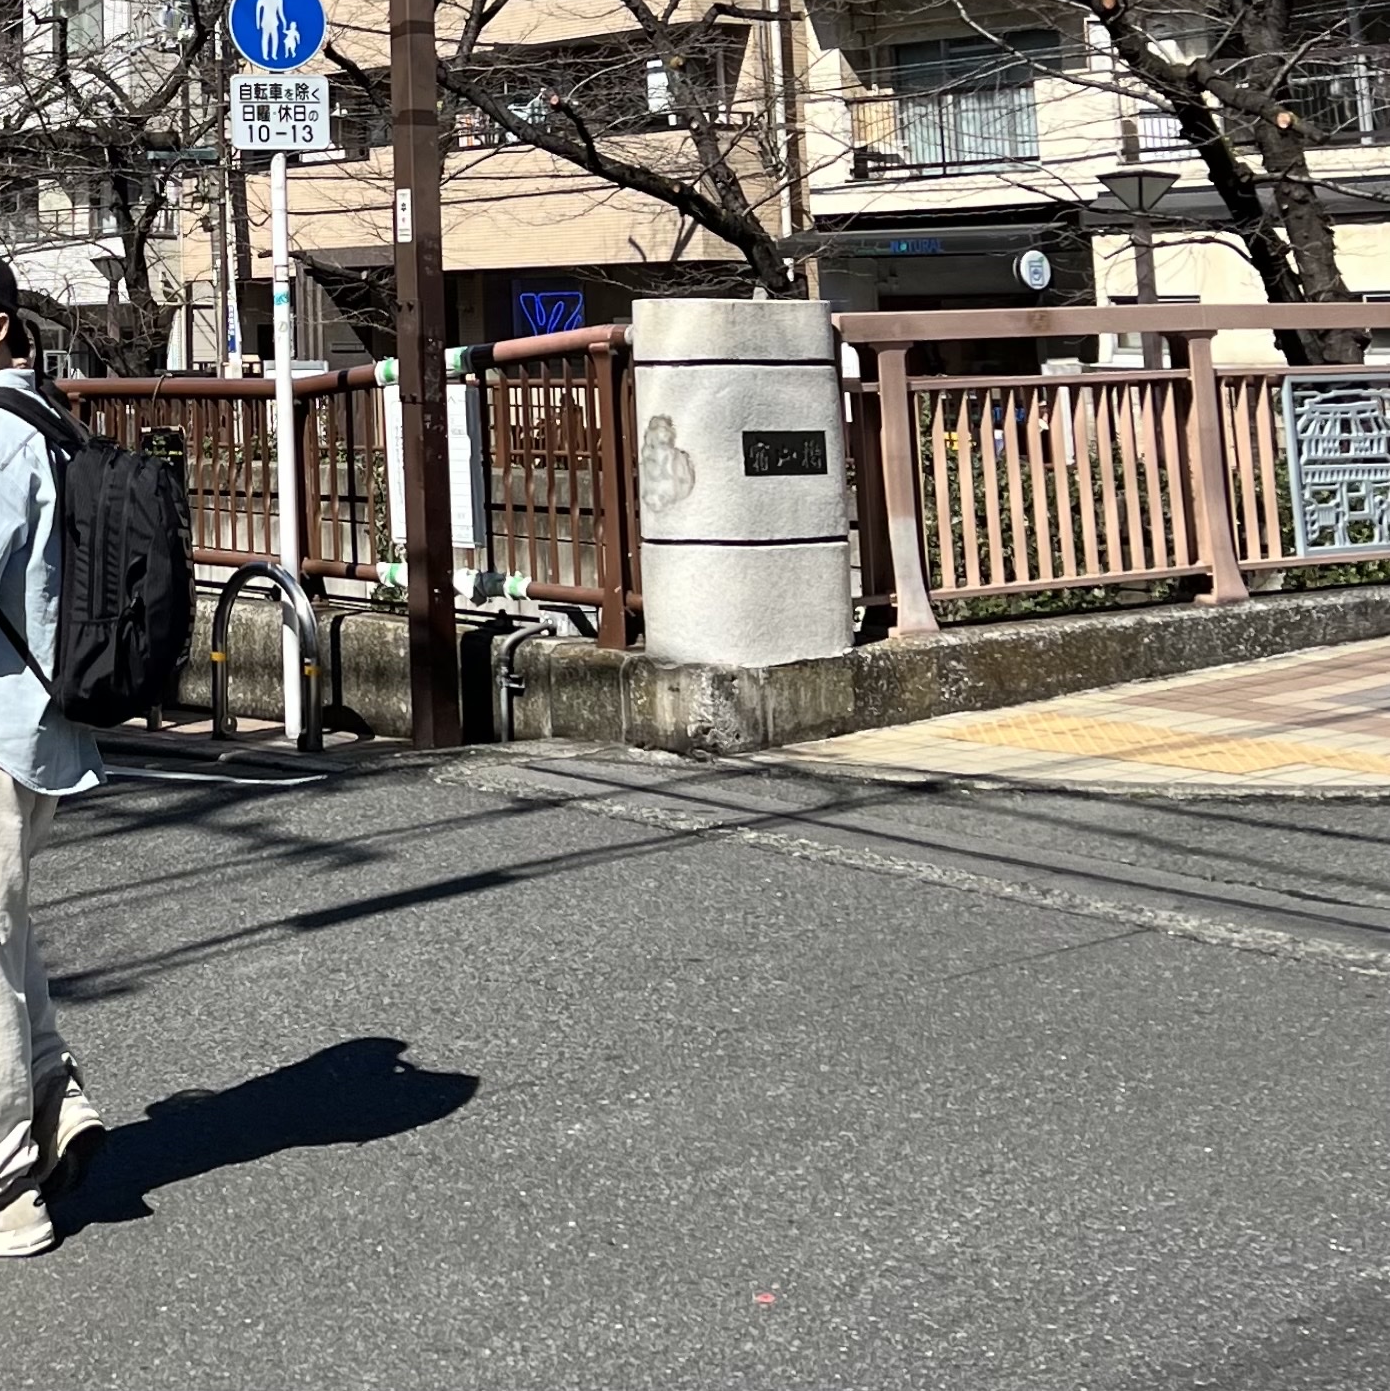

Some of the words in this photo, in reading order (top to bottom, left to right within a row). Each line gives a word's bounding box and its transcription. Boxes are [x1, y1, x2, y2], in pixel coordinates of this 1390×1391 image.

[239, 83, 320, 101] 自転車を除く
[248, 124, 314, 143] 10-13
